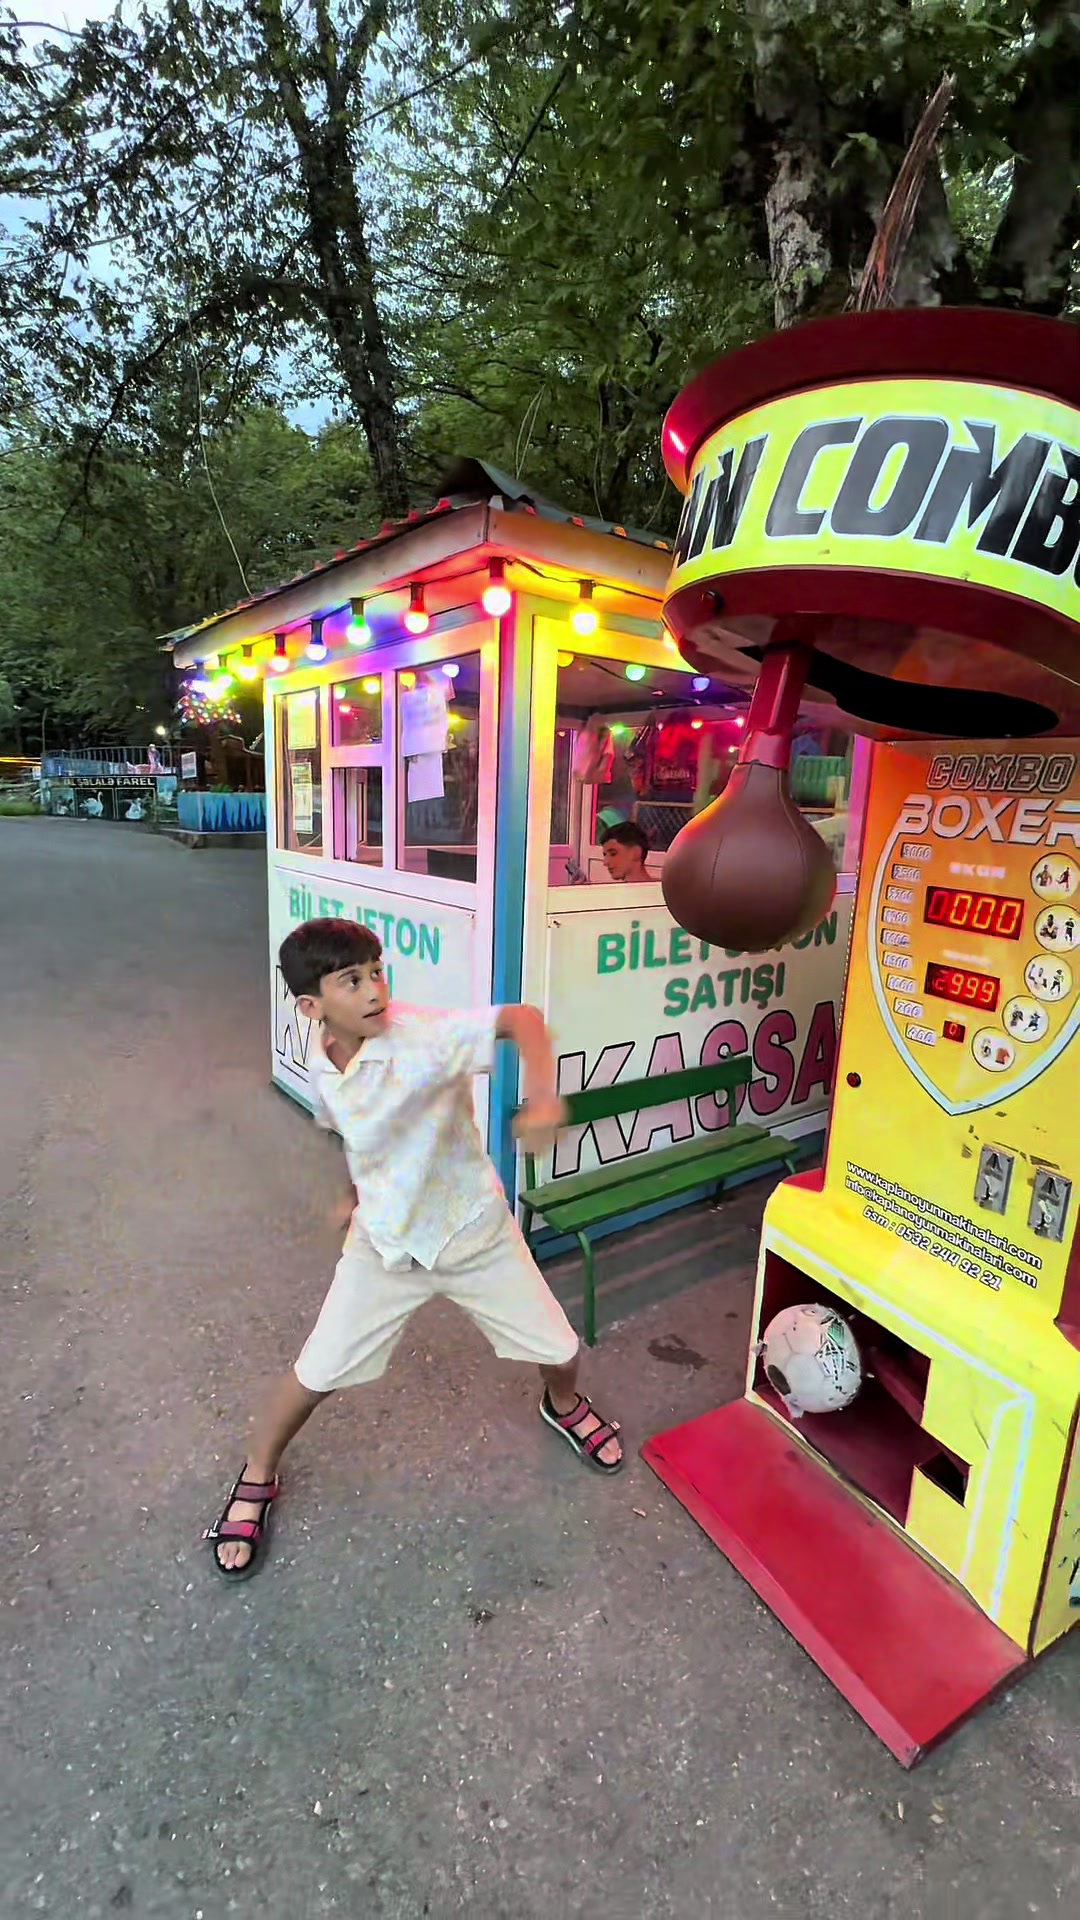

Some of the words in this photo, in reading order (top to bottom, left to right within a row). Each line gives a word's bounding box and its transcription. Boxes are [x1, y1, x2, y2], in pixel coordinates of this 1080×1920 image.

[766, 416, 1080, 589] COMB
[116, 777, 155, 786] FAREL
[926, 754, 1076, 794] COMBO
[663, 962, 786, 1017] SATIŞI
[845, 1175, 1037, 1289] info@kaplanoyunmakinalari.com
[847, 1161, 1042, 1269] www.kaplanoyunmakinalari.com
[863, 1205, 889, 1228] Gsm
[895, 1223, 931, 1251] 0532
[930, 1243, 960, 1266] 244
[959, 1258, 981, 1279] 92
[980, 1270, 1002, 1291] 21
